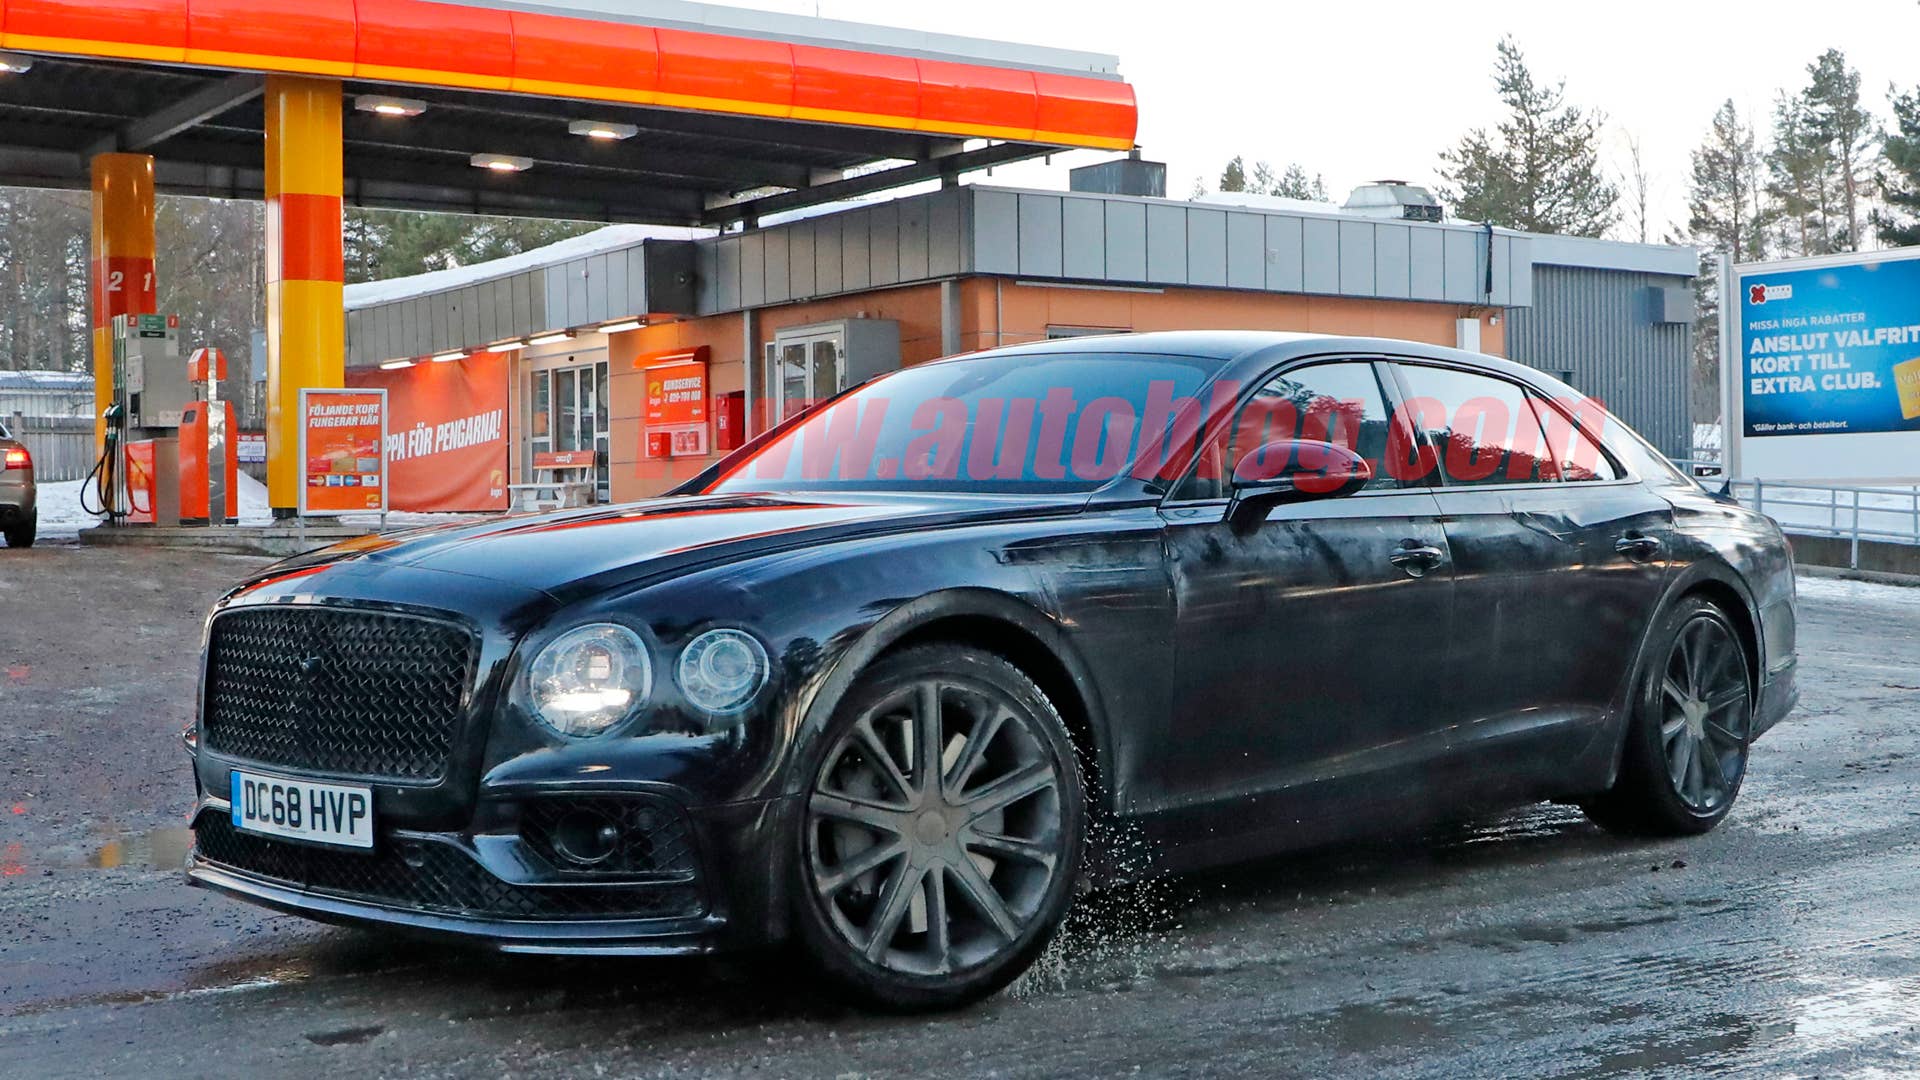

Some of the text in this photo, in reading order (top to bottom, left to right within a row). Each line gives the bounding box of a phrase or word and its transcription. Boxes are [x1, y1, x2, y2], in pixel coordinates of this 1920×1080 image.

[108, 271, 123, 291] 2
[143, 272, 152, 292] 1
[1750, 312, 1866, 330] MISSA INGA RABATTER
[1751, 332, 1829, 354] ANSLUT
[1751, 353, 1851, 374] KORT TILL
[1752, 372, 1881, 395] EXTRA CLUB.
[309, 404, 380, 416] FÖLJANDE KORT
[309, 416, 358, 428] FUNGERAR
[408, 422, 433, 458] FÖR
[435, 409, 502, 453] PENGARNA!
[244, 779, 366, 835] DC68 HVP
